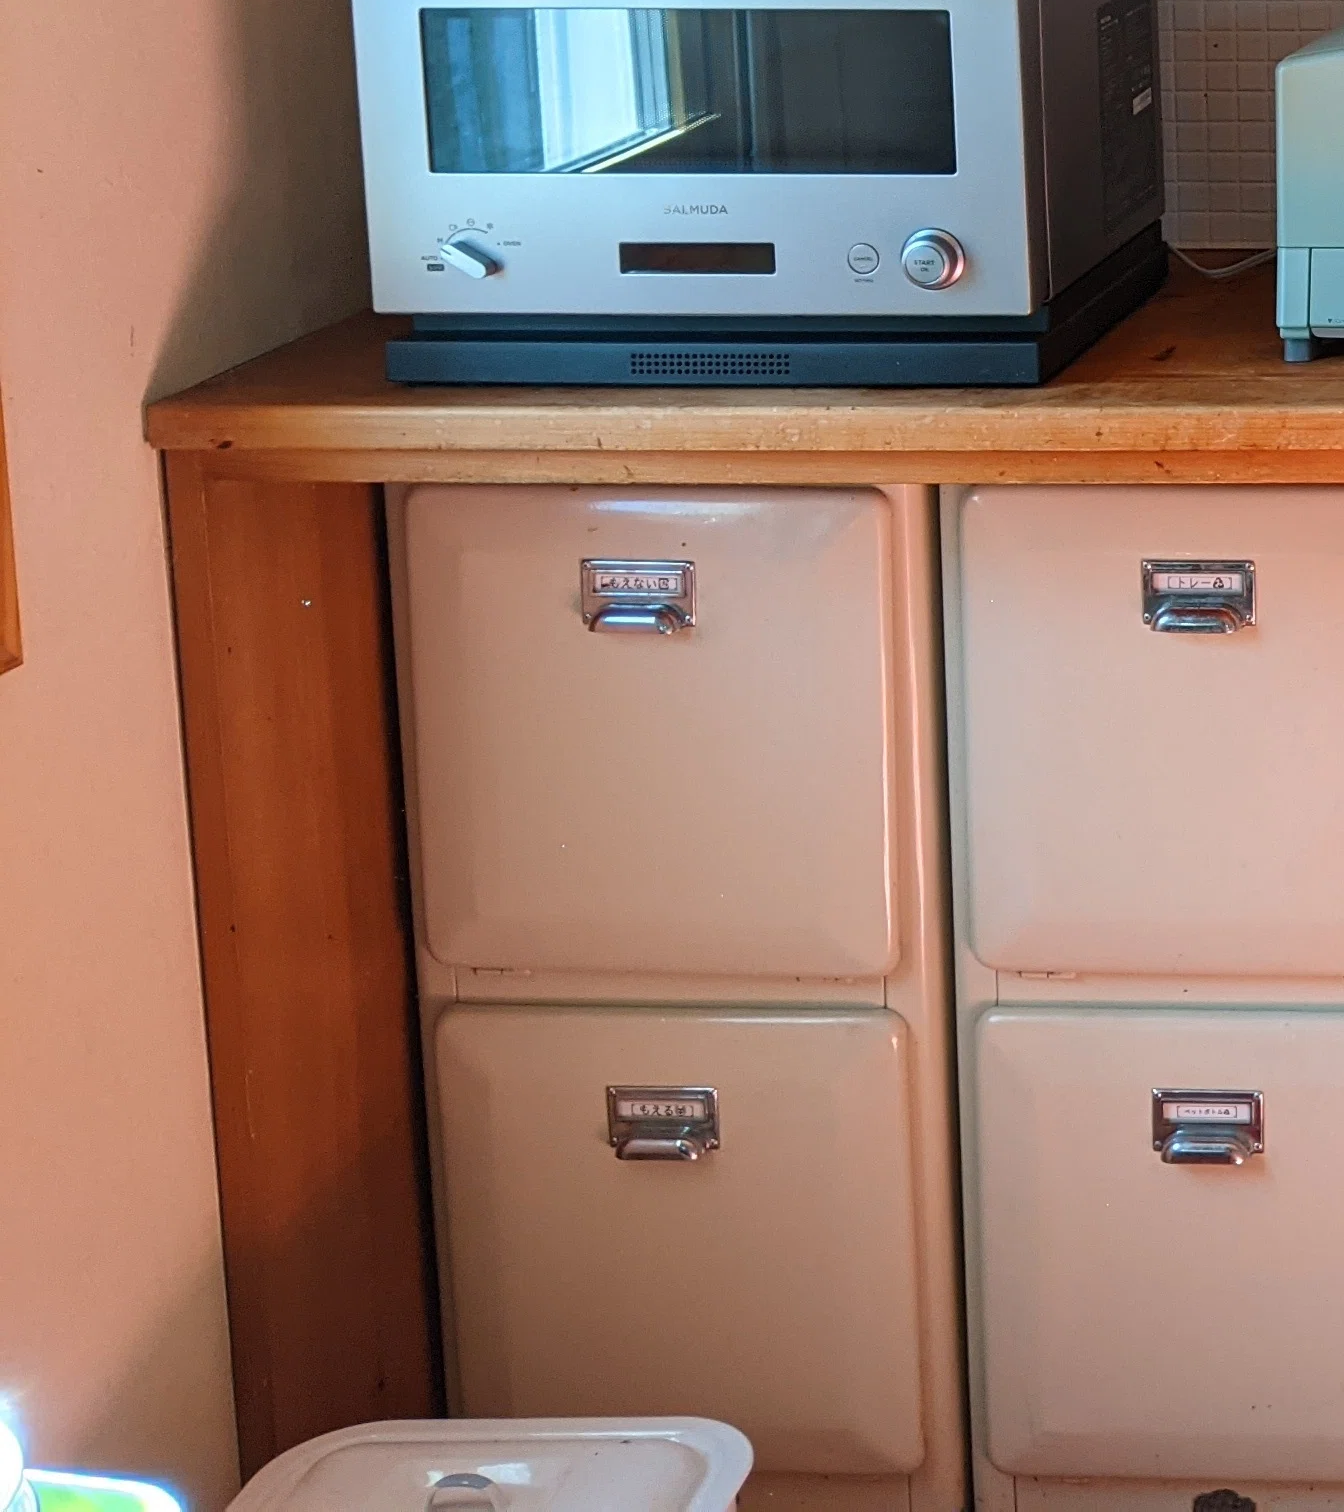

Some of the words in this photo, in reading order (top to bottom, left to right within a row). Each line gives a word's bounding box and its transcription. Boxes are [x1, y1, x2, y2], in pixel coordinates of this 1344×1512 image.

[663, 204, 729, 215] BALMUDA
[609, 576, 657, 590] もえない
[1178, 577, 1211, 589] トレー
[639, 1104, 674, 1117] もえる
